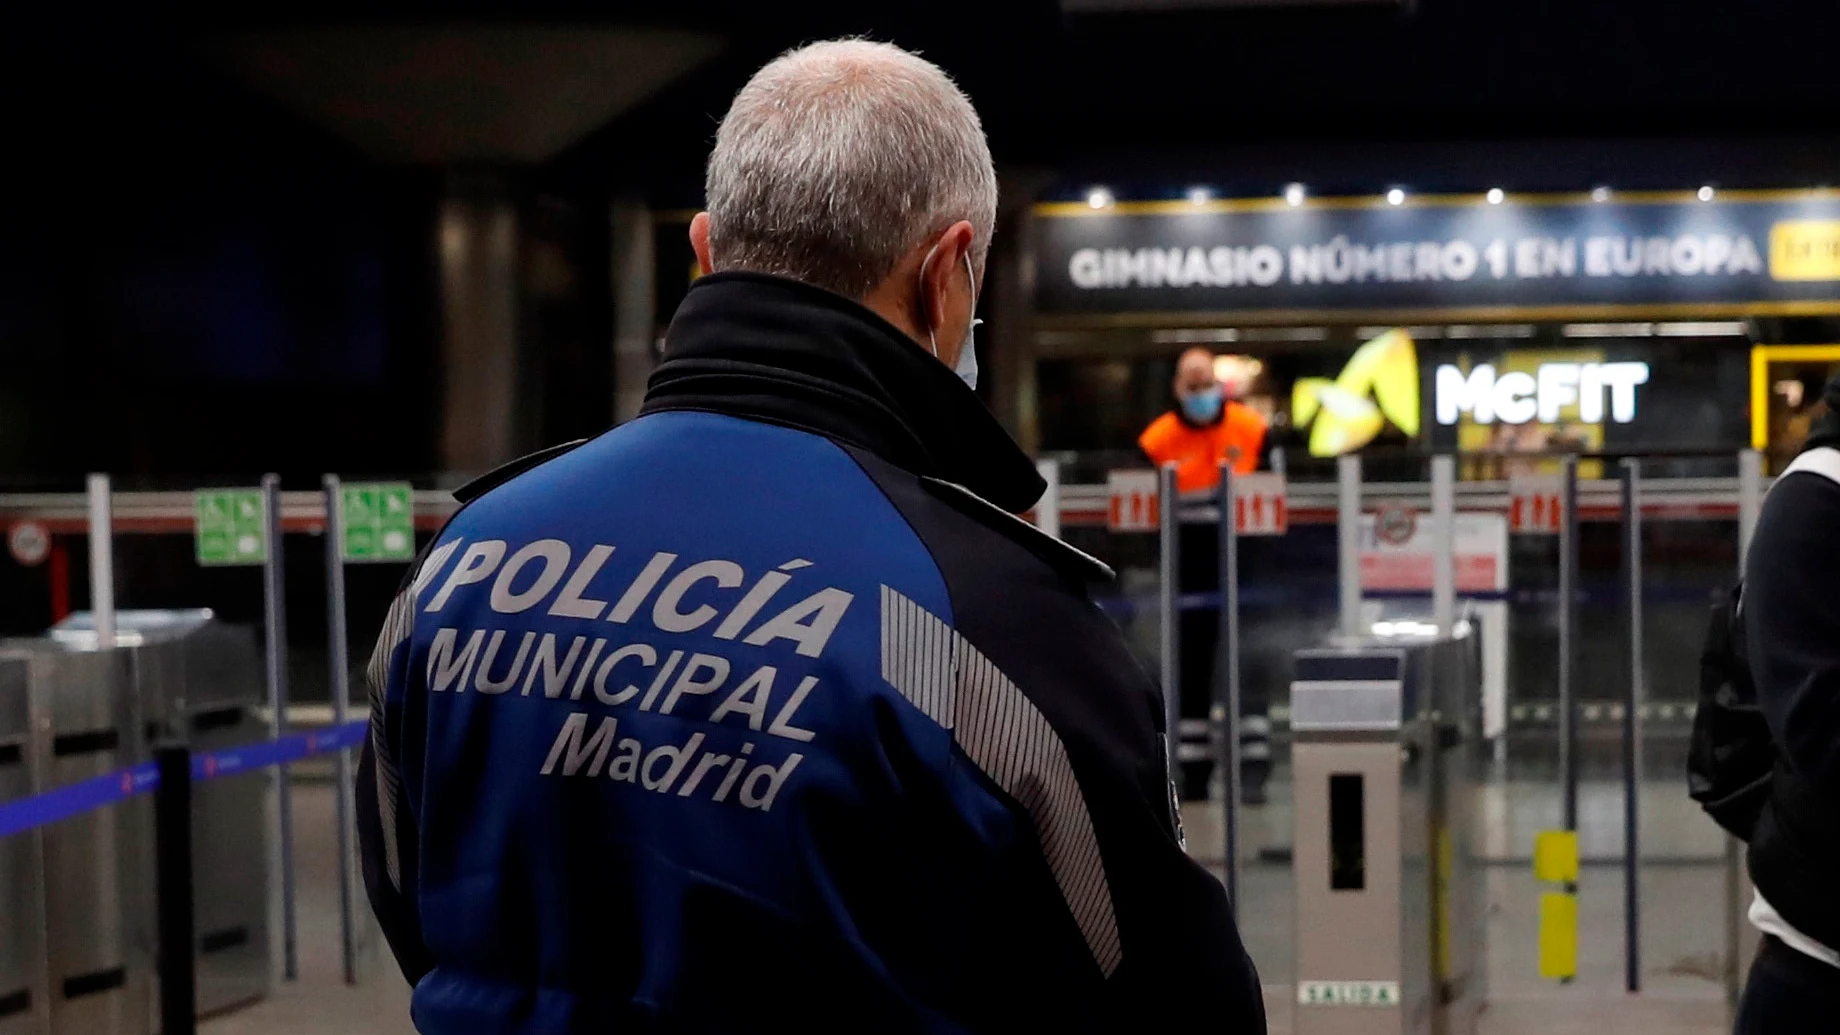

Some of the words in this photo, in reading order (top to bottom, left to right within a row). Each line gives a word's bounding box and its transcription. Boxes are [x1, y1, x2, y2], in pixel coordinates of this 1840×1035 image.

[1068, 245, 1284, 289] GIMNASIO
[1288, 234, 1478, 285] NÚMERO
[1484, 238, 1507, 279] 1
[1515, 236, 1577, 279] EN
[1584, 233, 1764, 277] EUROPA
[1435, 361, 1649, 425] McFIT
[423, 538, 855, 658] POLICÍA
[426, 627, 820, 743] MUNICIPAL
[539, 712, 804, 812] Madrid
[1304, 983, 1391, 1004] SALIDA
